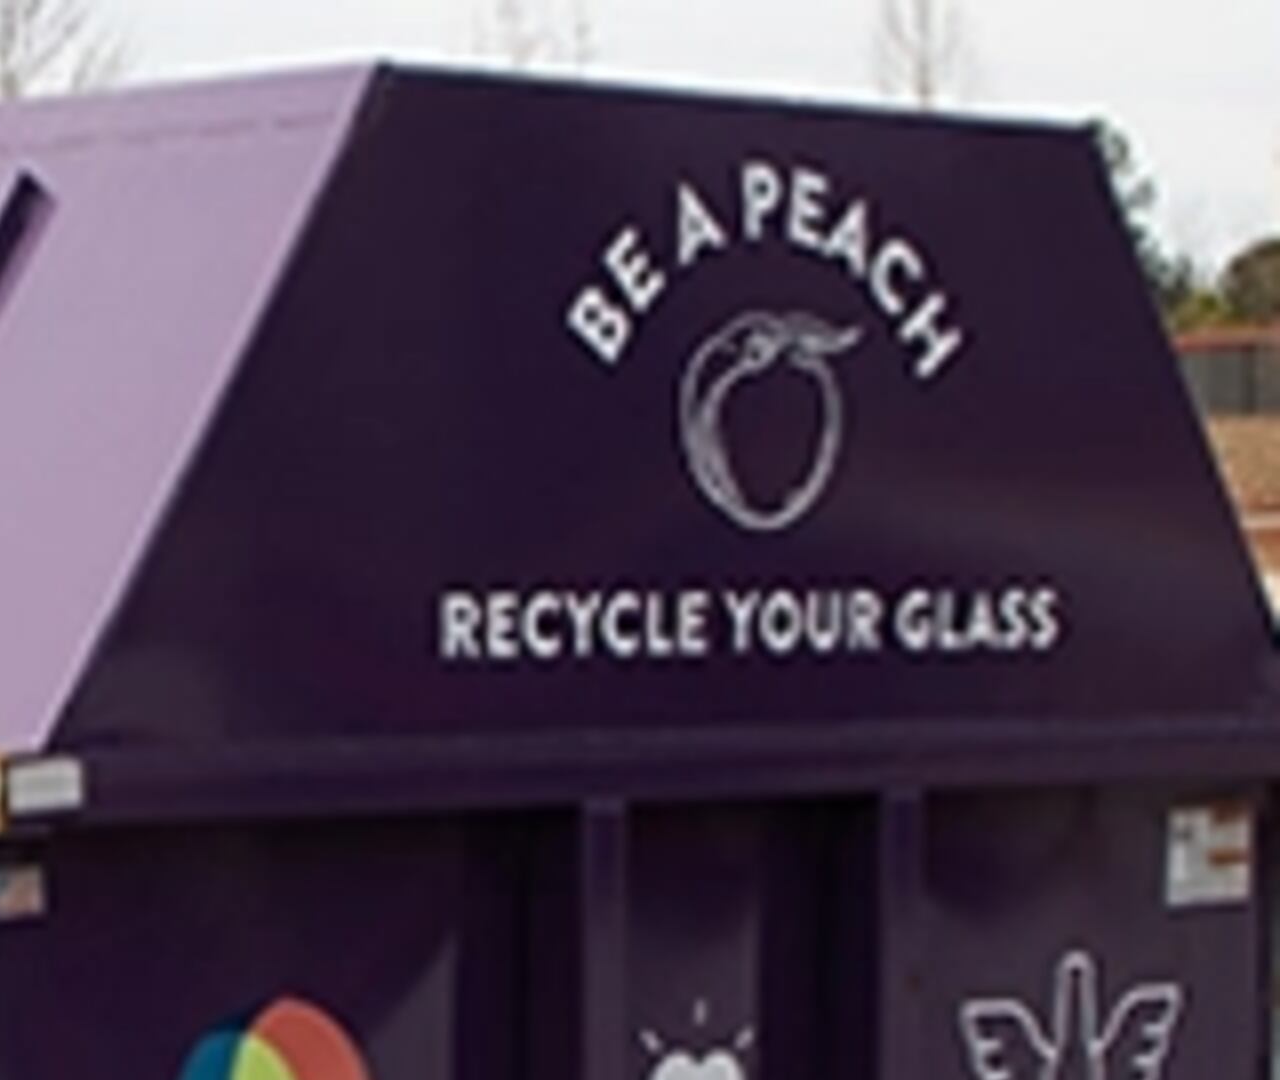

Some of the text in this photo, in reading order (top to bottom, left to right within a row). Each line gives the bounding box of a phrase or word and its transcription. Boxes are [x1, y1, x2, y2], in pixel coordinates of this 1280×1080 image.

[566, 161, 962, 377] BE A PEACH
[440, 590, 1060, 659] RECYCLE YOUR GLASS
